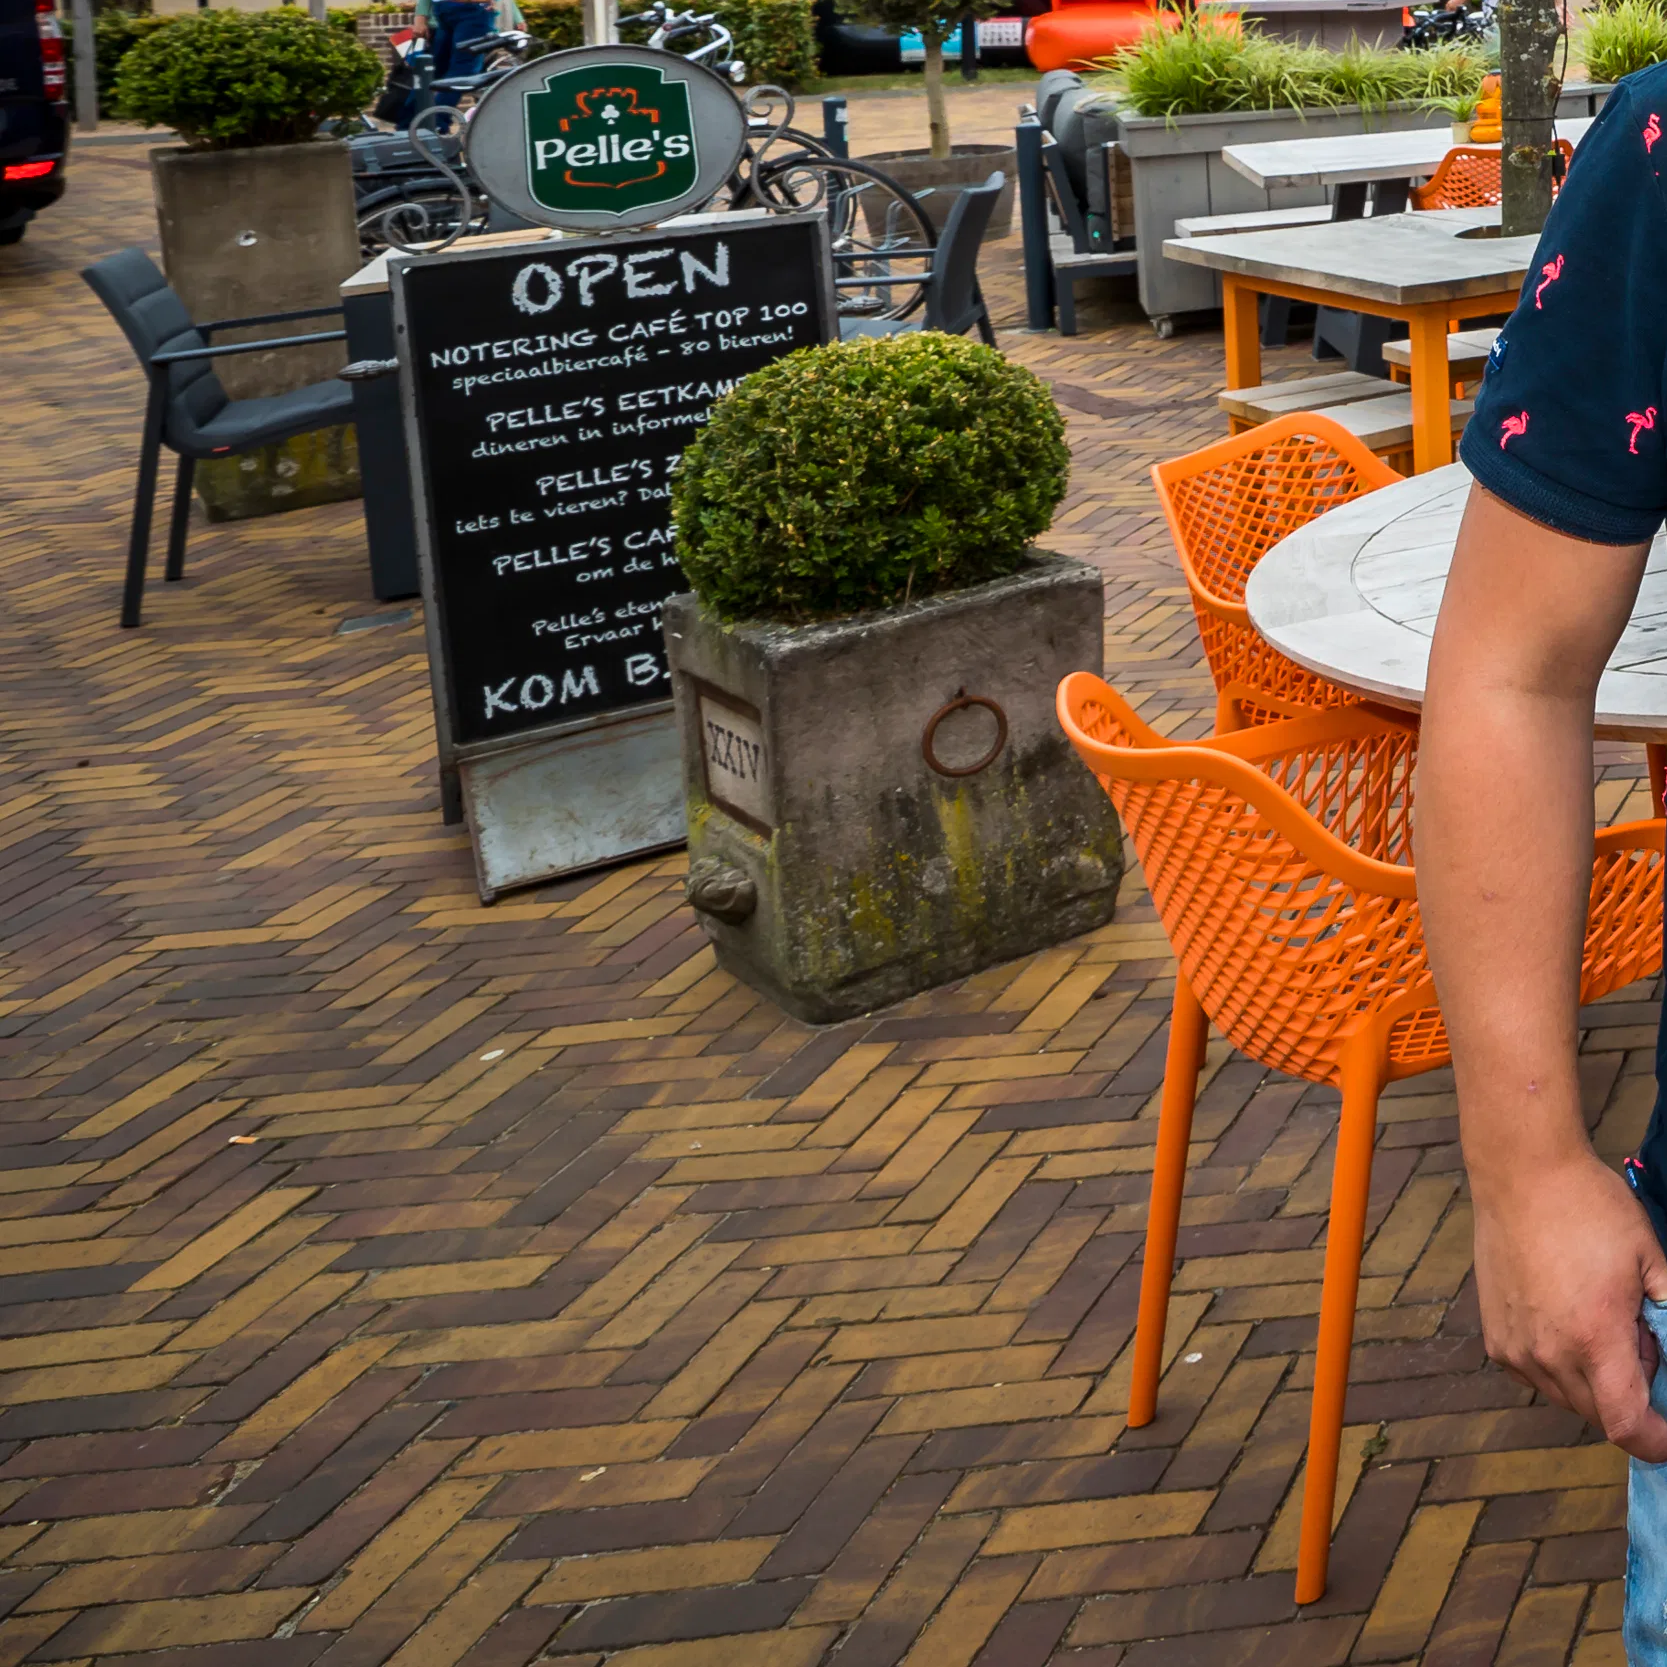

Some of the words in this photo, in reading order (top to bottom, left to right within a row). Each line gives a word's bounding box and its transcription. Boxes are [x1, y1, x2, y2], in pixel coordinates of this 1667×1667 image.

[534, 129, 690, 170] Pelle's
[512, 241, 730, 316] OPEN
[431, 328, 598, 368] NOTERING
[608, 308, 687, 342] CAFÉ
[695, 306, 749, 330] TOP
[760, 301, 808, 322] 100
[452, 345, 648, 396] speciaalbiercafé
[680, 339, 711, 356] 80
[719, 326, 795, 351] bieren!
[485, 396, 606, 432] PELLE'S
[618, 376, 747, 411] EETKAM
[471, 434, 570, 458] dineren
[578, 426, 603, 442] in
[612, 407, 712, 436] informel
[536, 459, 652, 495] PELLE'S
[455, 515, 500, 534] iets
[510, 508, 535, 525] te
[543, 490, 628, 517] vieren?
[492, 537, 612, 575] PELLE'S
[623, 524, 680, 549] CAF
[576, 567, 614, 583] om
[623, 556, 654, 574] de
[531, 607, 606, 636] Pelle's
[564, 623, 644, 650] Ervaar
[483, 665, 601, 719] KOM
[707, 720, 760, 783] XXIV
